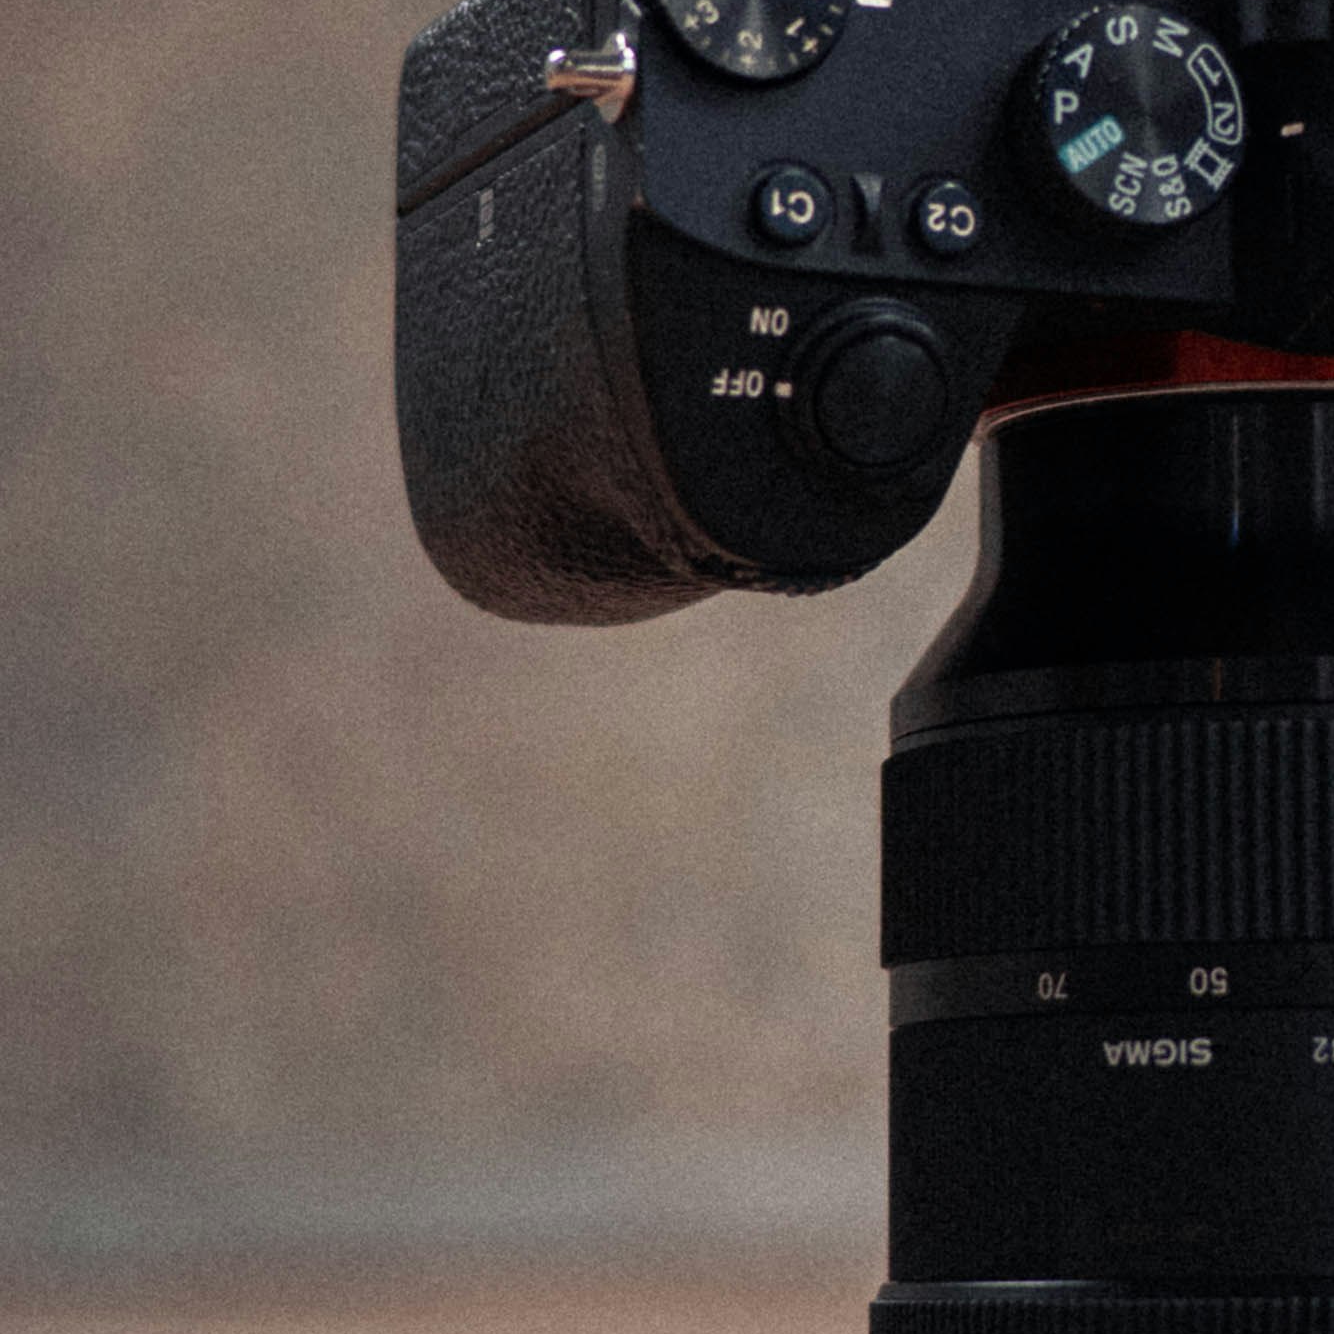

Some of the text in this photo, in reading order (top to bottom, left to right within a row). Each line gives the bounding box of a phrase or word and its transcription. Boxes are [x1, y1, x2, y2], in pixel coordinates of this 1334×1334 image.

[1106, 14, 1139, 46] S
[1152, 17, 1190, 58] M
[1063, 43, 1094, 79] A
[1198, 56, 1222, 86] 1
[1054, 89, 1079, 125] P
[1214, 102, 1236, 136] 2
[1065, 119, 1123, 170] AUTO
[1108, 151, 1148, 216] SCN
[1152, 154, 1192, 218] S&Q
[771, 187, 815, 225] C1
[926, 203, 976, 237] C2
[750, 305, 789, 337] ON
[710, 369, 765, 398] OFF
[1037, 971, 1069, 1001] 70
[1189, 966, 1229, 996] 50
[1102, 1037, 1213, 1066] SIGMA
